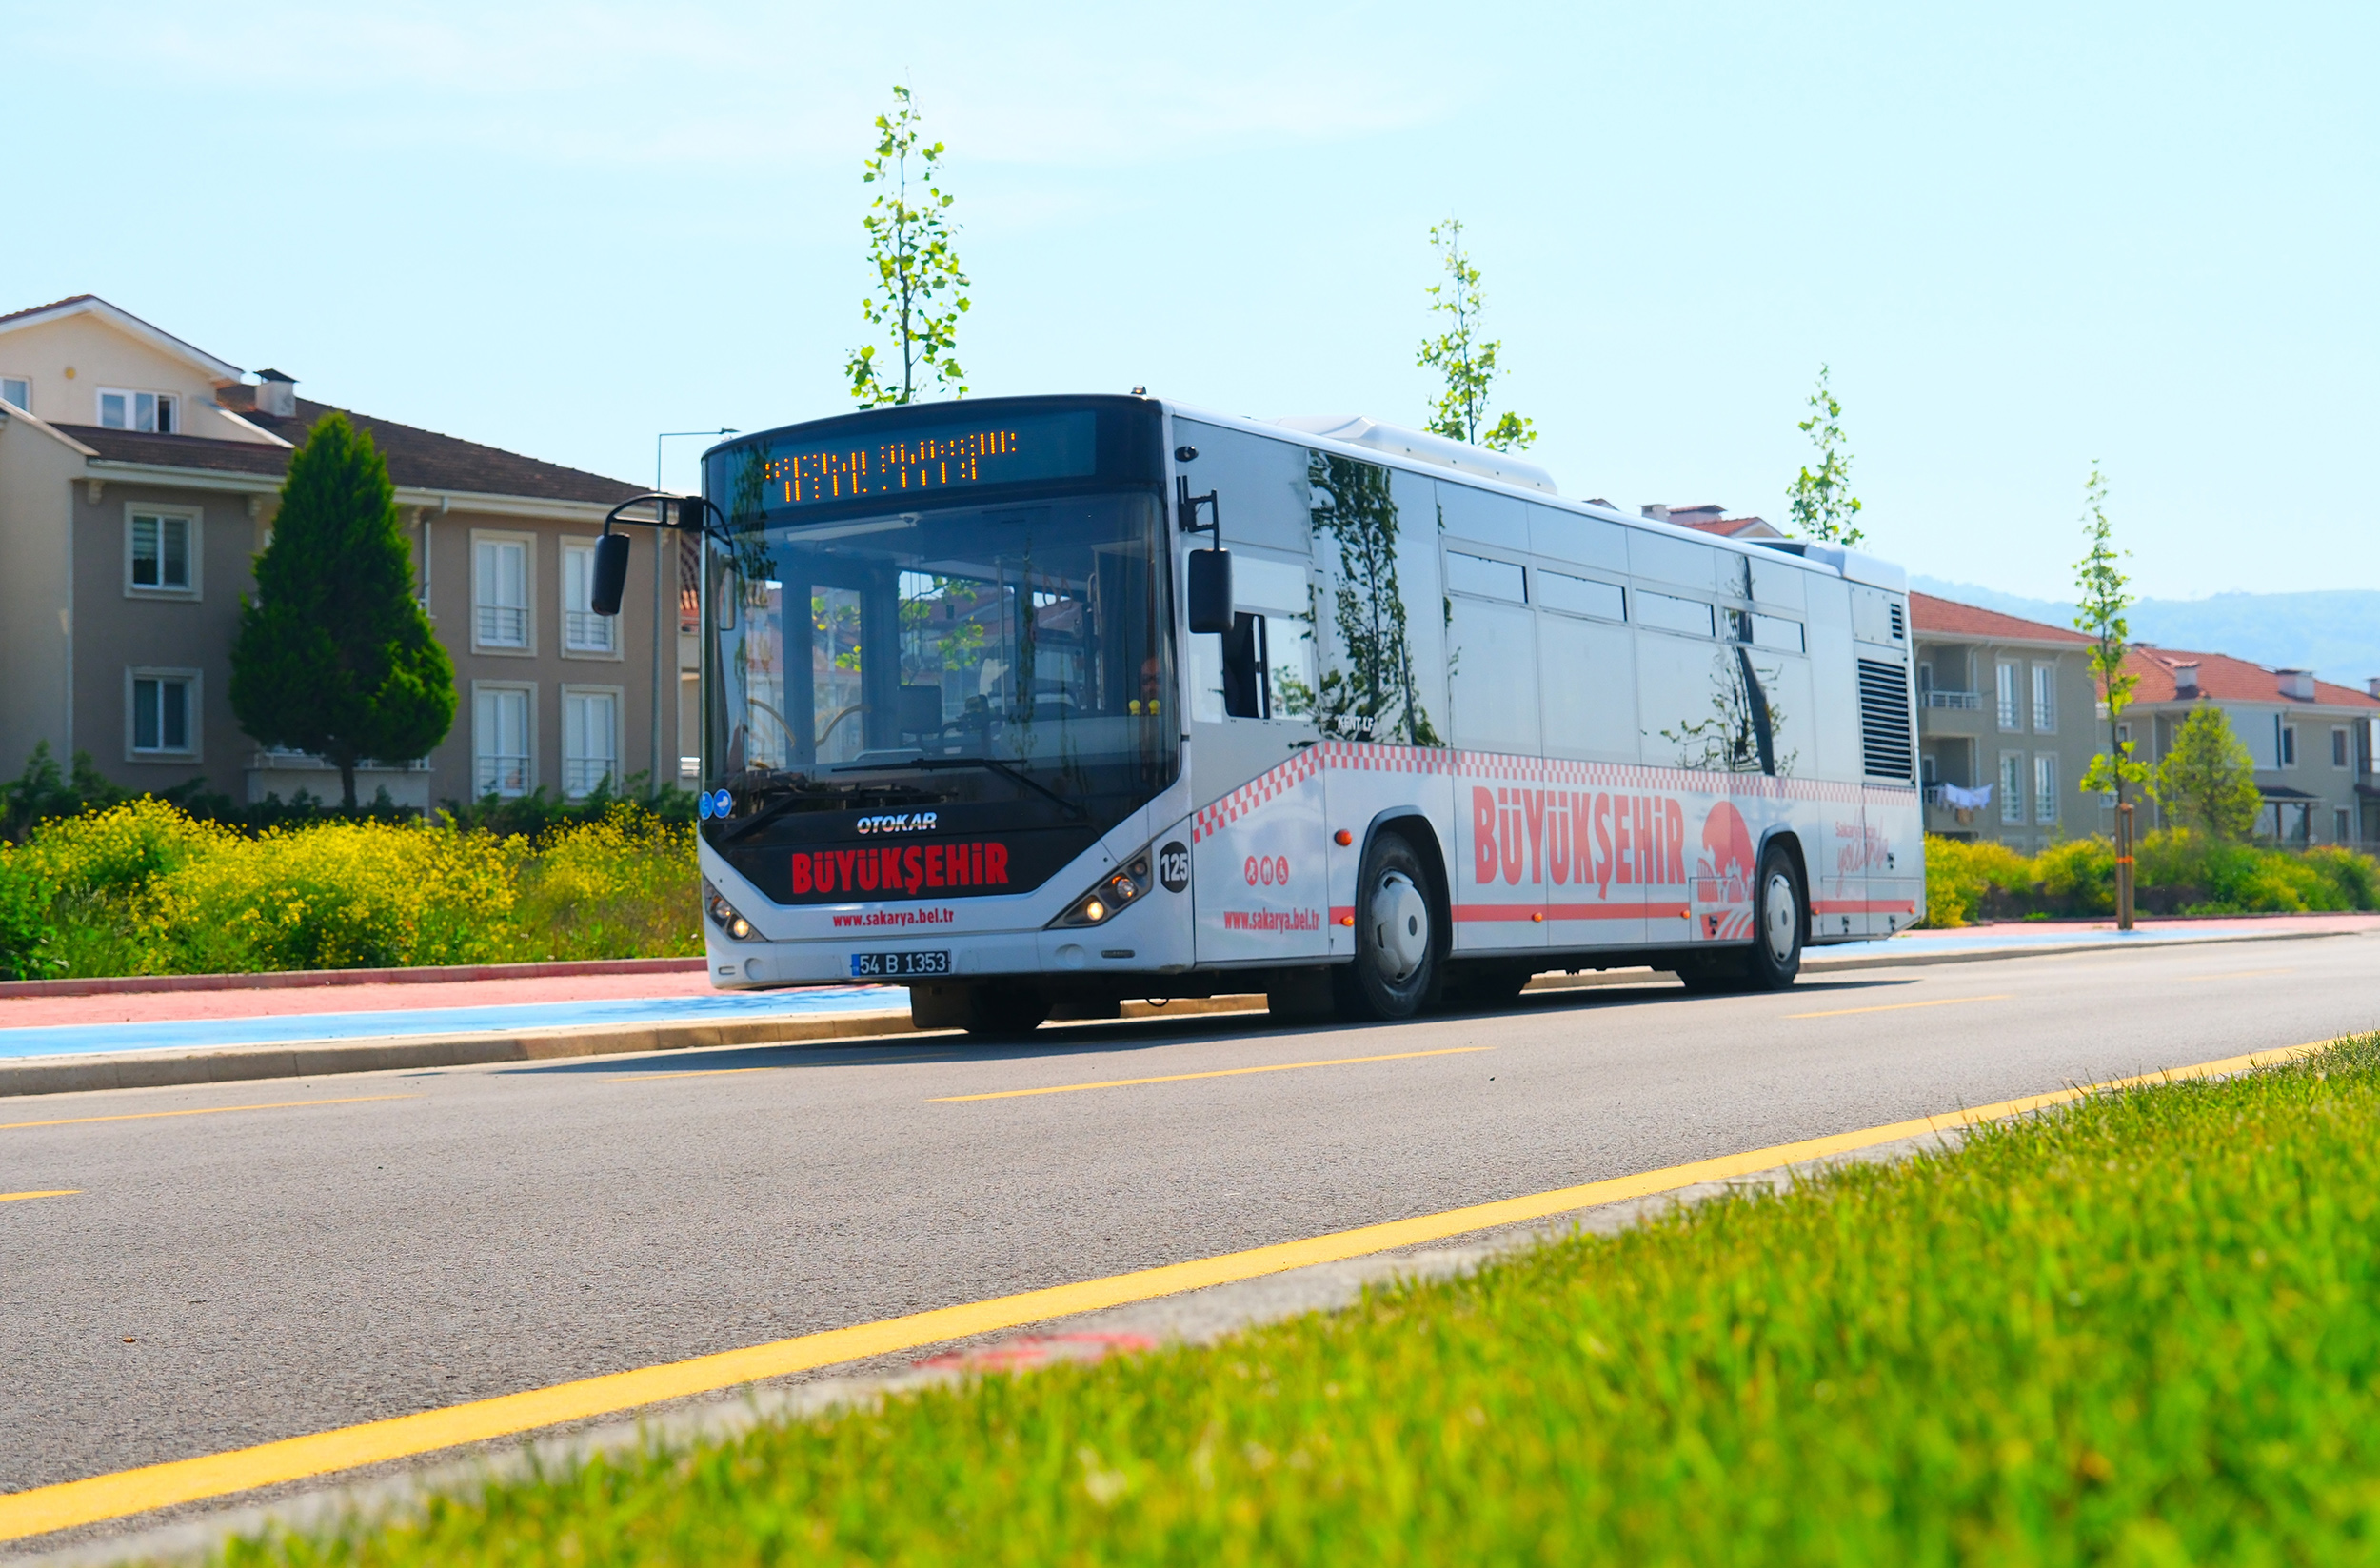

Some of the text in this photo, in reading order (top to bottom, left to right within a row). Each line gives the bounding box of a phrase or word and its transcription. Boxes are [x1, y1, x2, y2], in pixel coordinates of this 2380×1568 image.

[1337, 714, 1373, 732] KENT LF
[857, 812, 938, 834] OTOKAR
[1472, 785, 1686, 900] BÜYÜKŞEHİR
[792, 842, 1009, 895] BÜYÜKŞEHİR
[1160, 853, 1188, 882] 125
[833, 908, 954, 927] www.sakarya.bel.tr
[1224, 907, 1319, 934] www.sakarya.bel.tr
[860, 955, 880, 974] 54
[886, 954, 899, 973] B
[906, 953, 946, 972] 1353
